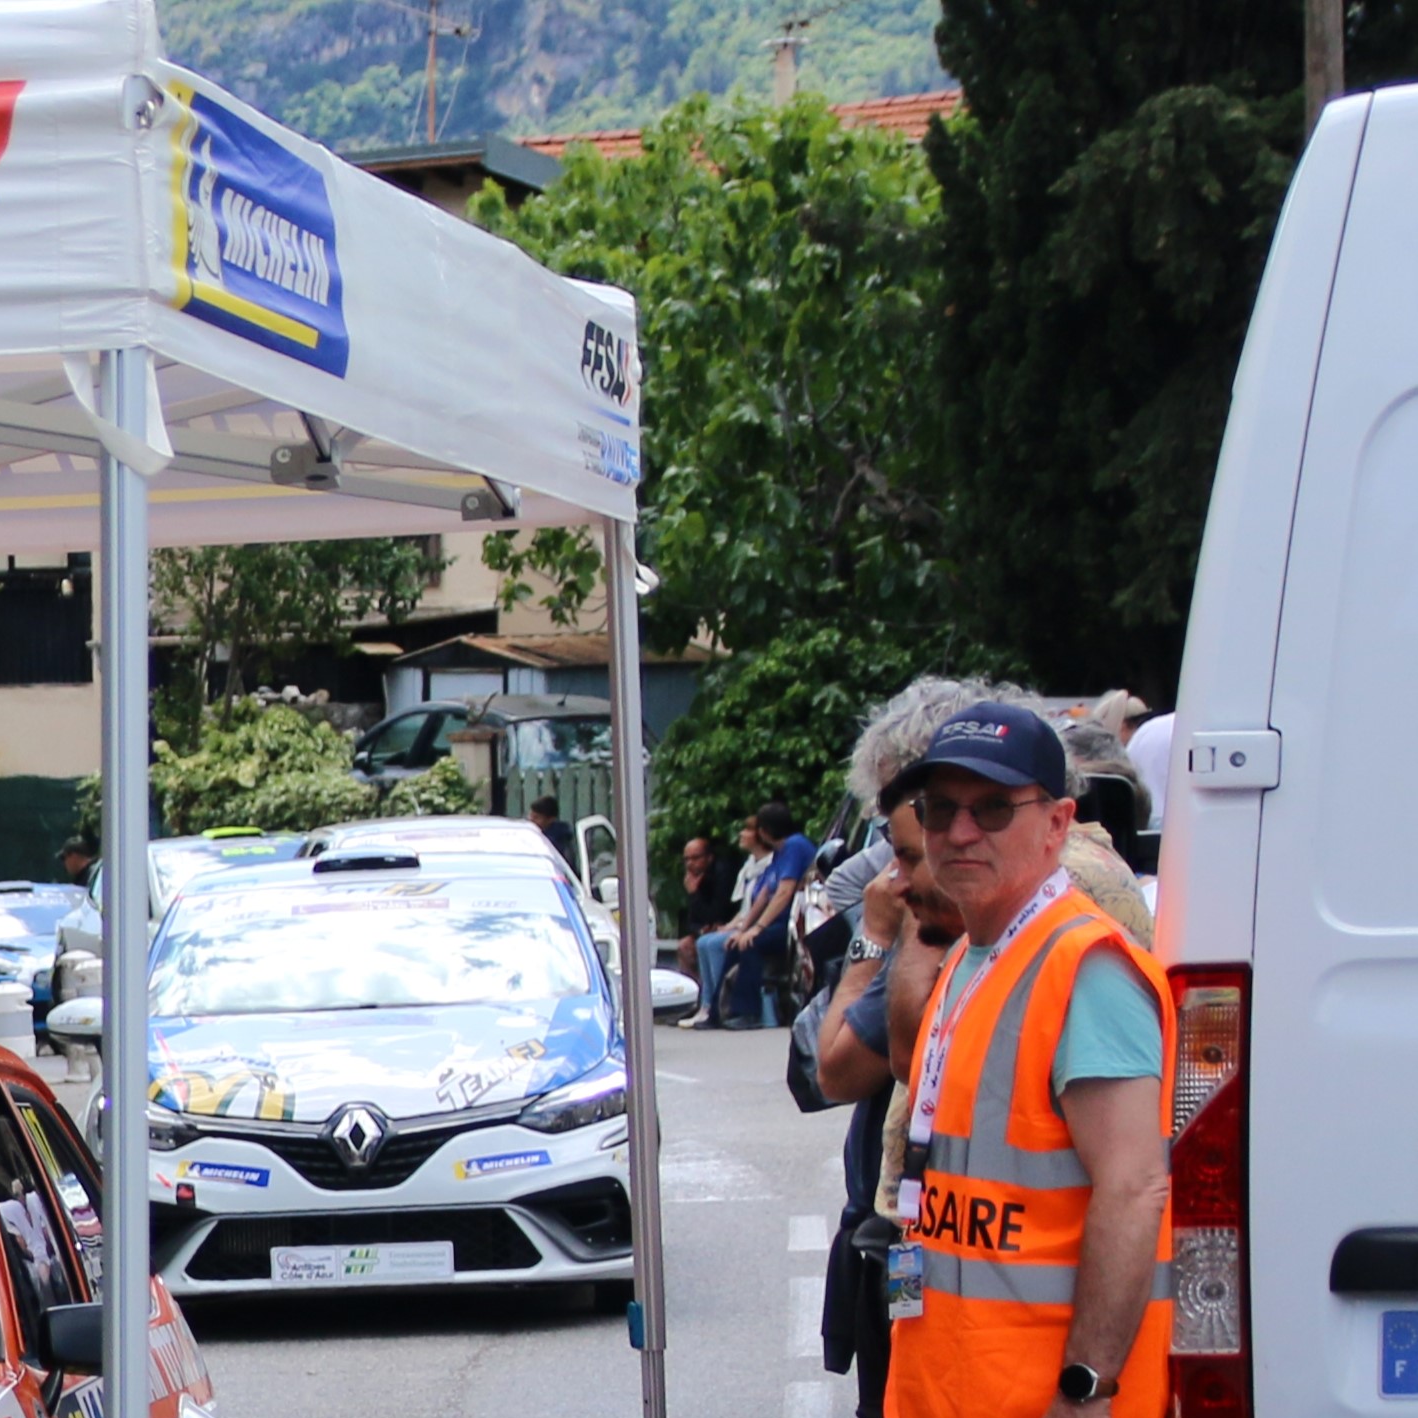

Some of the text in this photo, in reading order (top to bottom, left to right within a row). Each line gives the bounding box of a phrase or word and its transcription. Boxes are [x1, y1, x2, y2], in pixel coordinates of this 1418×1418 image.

[221, 187, 331, 308] MICHELIN
[482, 1155, 540, 1171] MICHELIN
[201, 1167, 261, 1182] MICHELIN
[1394, 1359, 1407, 1379] F
